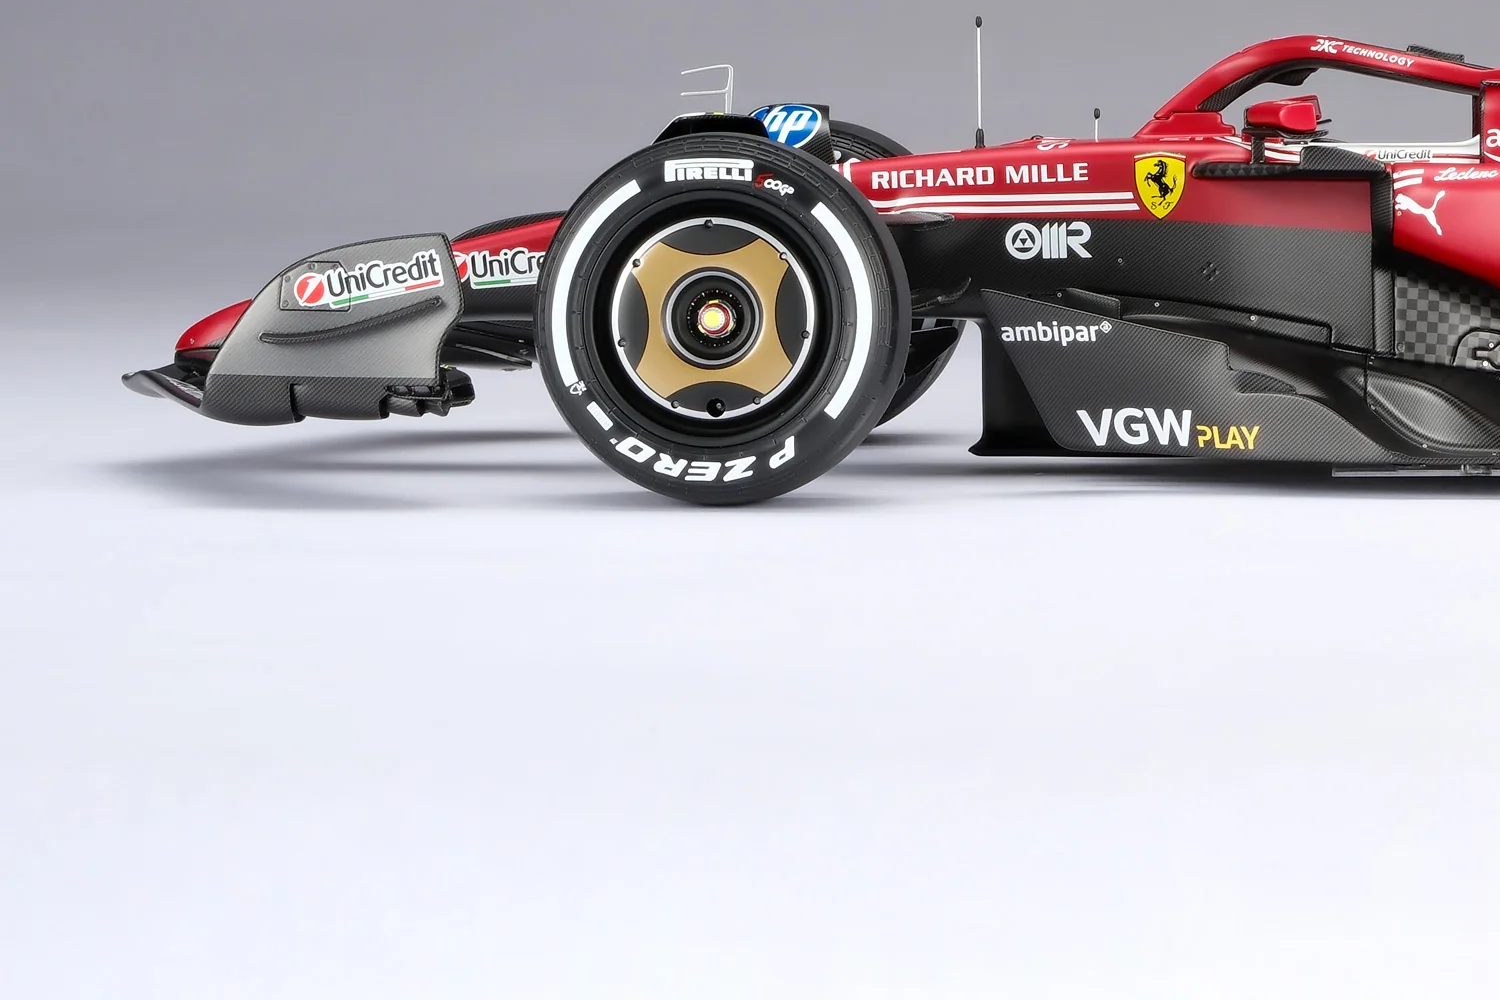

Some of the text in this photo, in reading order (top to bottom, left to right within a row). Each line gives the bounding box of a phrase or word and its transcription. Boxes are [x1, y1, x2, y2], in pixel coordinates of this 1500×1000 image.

[1342, 44, 1415, 68] TECHNOLOGY
[763, 105, 812, 144] hp
[1377, 149, 1431, 161] UniCredit
[664, 158, 754, 182] PIRELLI
[871, 162, 1089, 190] RICHARD MILLE
[327, 253, 440, 297] UniCredit
[1001, 321, 1099, 347] ambipar
[1076, 407, 1260, 449] VGW PLAY
[615, 435, 795, 482] P ZERO
